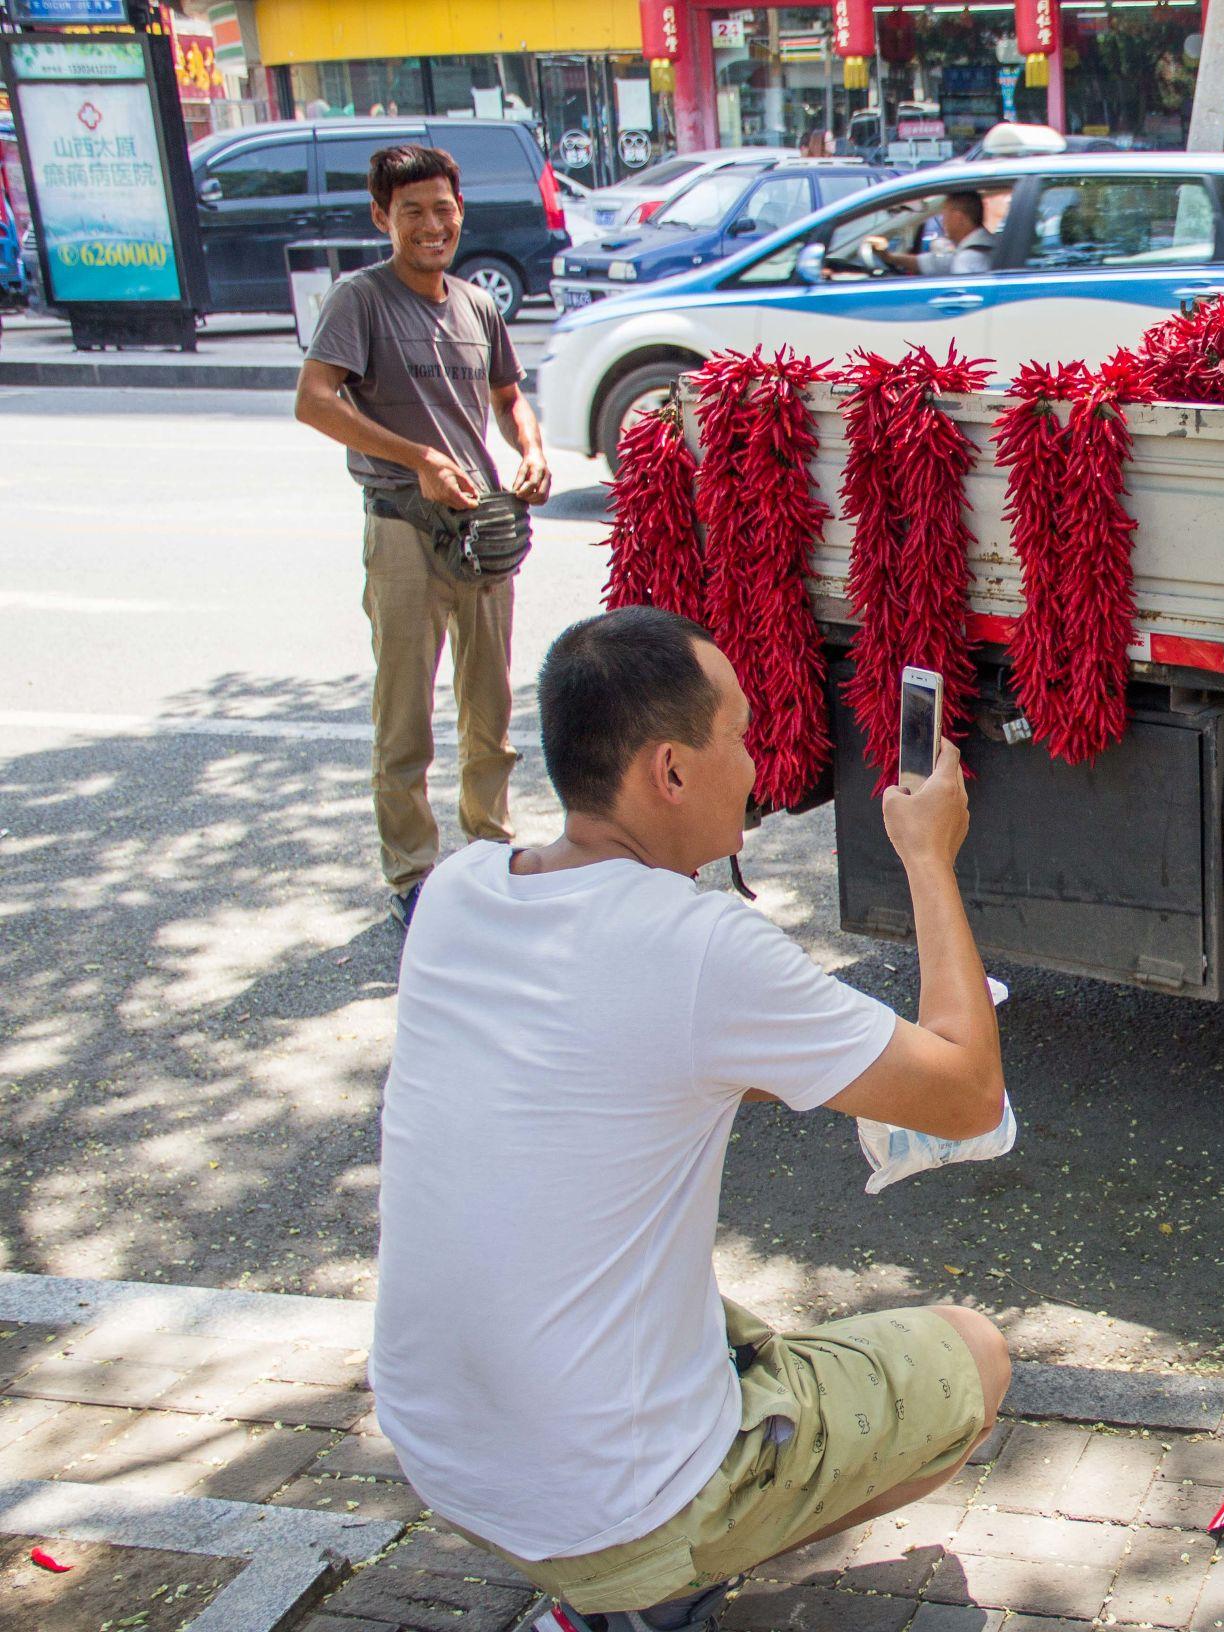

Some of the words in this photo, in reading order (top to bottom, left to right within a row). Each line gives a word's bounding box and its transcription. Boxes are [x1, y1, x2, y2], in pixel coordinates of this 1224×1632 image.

[54, 137, 137, 157] 山西太原
[81, 241, 167, 268] 6260000
